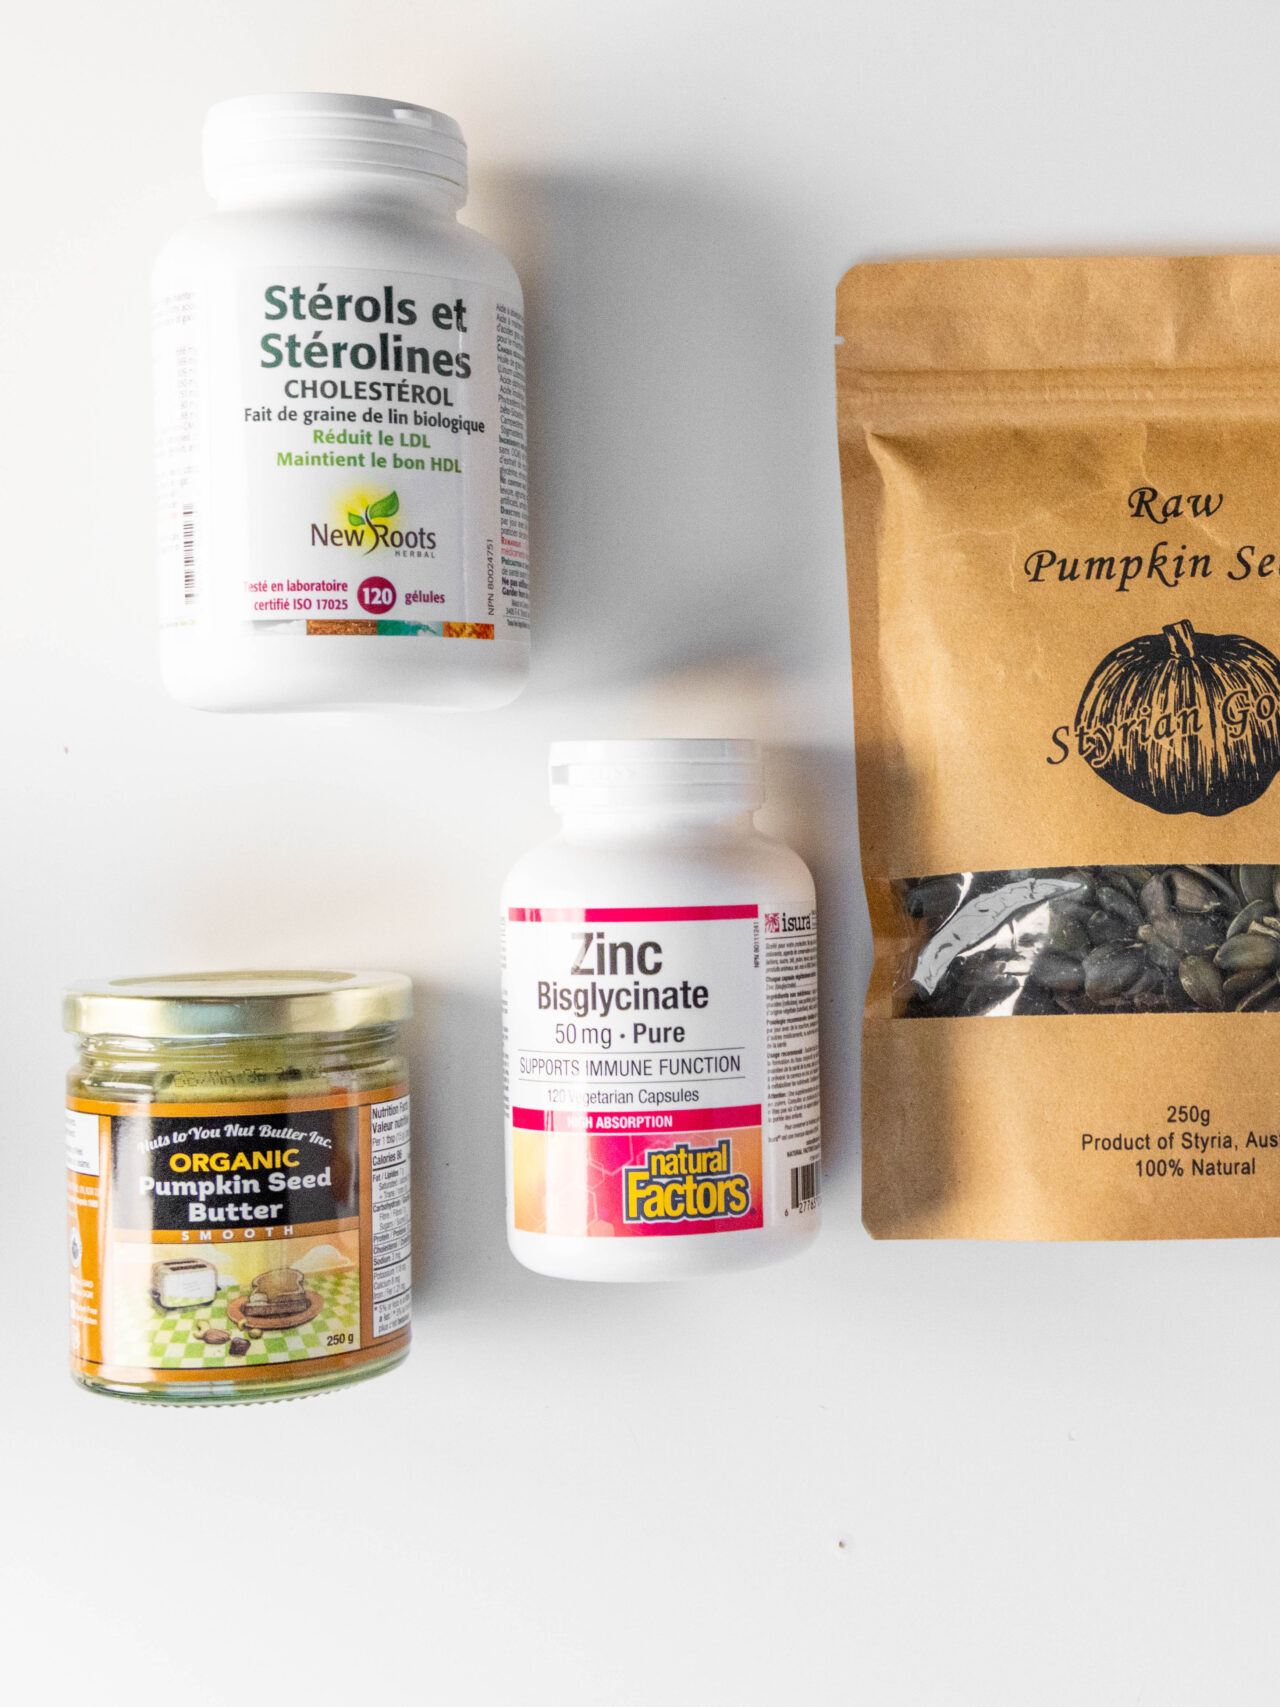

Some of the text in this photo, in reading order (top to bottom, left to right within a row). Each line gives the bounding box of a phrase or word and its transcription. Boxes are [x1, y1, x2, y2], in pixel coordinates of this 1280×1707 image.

[264, 283, 467, 332] Stérols et
[260, 330, 471, 378] Stérolines
[284, 379, 454, 406] CHOLESTÉROL
[244, 408, 485, 434] Fait de graine de lin biologique
[313, 430, 431, 448] Réduit le LDL
[276, 452, 462, 473] Maintient le bon HDL
[1128, 487, 1223, 524] Raw
[311, 523, 436, 549] New Roots
[1024, 541, 1212, 592] Pumpkin
[271, 583, 283, 592] en
[287, 579, 348, 592] laboratoire
[254, 598, 348, 611] certifié ISO 17025
[363, 588, 445, 605] 120 gélules
[1046, 706, 1202, 766] Styrian
[782, 913, 810, 932] isura
[571, 932, 662, 975] Zinc
[538, 980, 708, 1017] Bisglycinate
[556, 1023, 685, 1049] 50 mg Pure
[520, 1055, 741, 1077] SUPPORTS IMMUNE FUNCTION
[548, 1089, 699, 1105] 120 Capsules
[372, 1105, 398, 1119] Nutrition
[596, 1116, 672, 1128] ABSORPTION
[1167, 1106, 1210, 1126] 250g
[372, 1121, 393, 1133] Valeur
[137, 1124, 332, 1152] Nuts to You Nut Butter Inc.
[1082, 1134, 1150, 1150] Product
[1157, 1133, 1174, 1149] of
[1181, 1132, 1238, 1152] Styria,
[169, 1149, 300, 1172] ORGANIC
[373, 1153, 395, 1166] Calories
[651, 1143, 727, 1175] natural
[1136, 1158, 1255, 1177] 100% Natural
[139, 1167, 332, 1201] Pumpkin Seed
[628, 1171, 746, 1218] Factors
[188, 1202, 283, 1222] Butter
[182, 1225, 294, 1240] SMOOTH
[327, 1332, 354, 1346] 250 g
